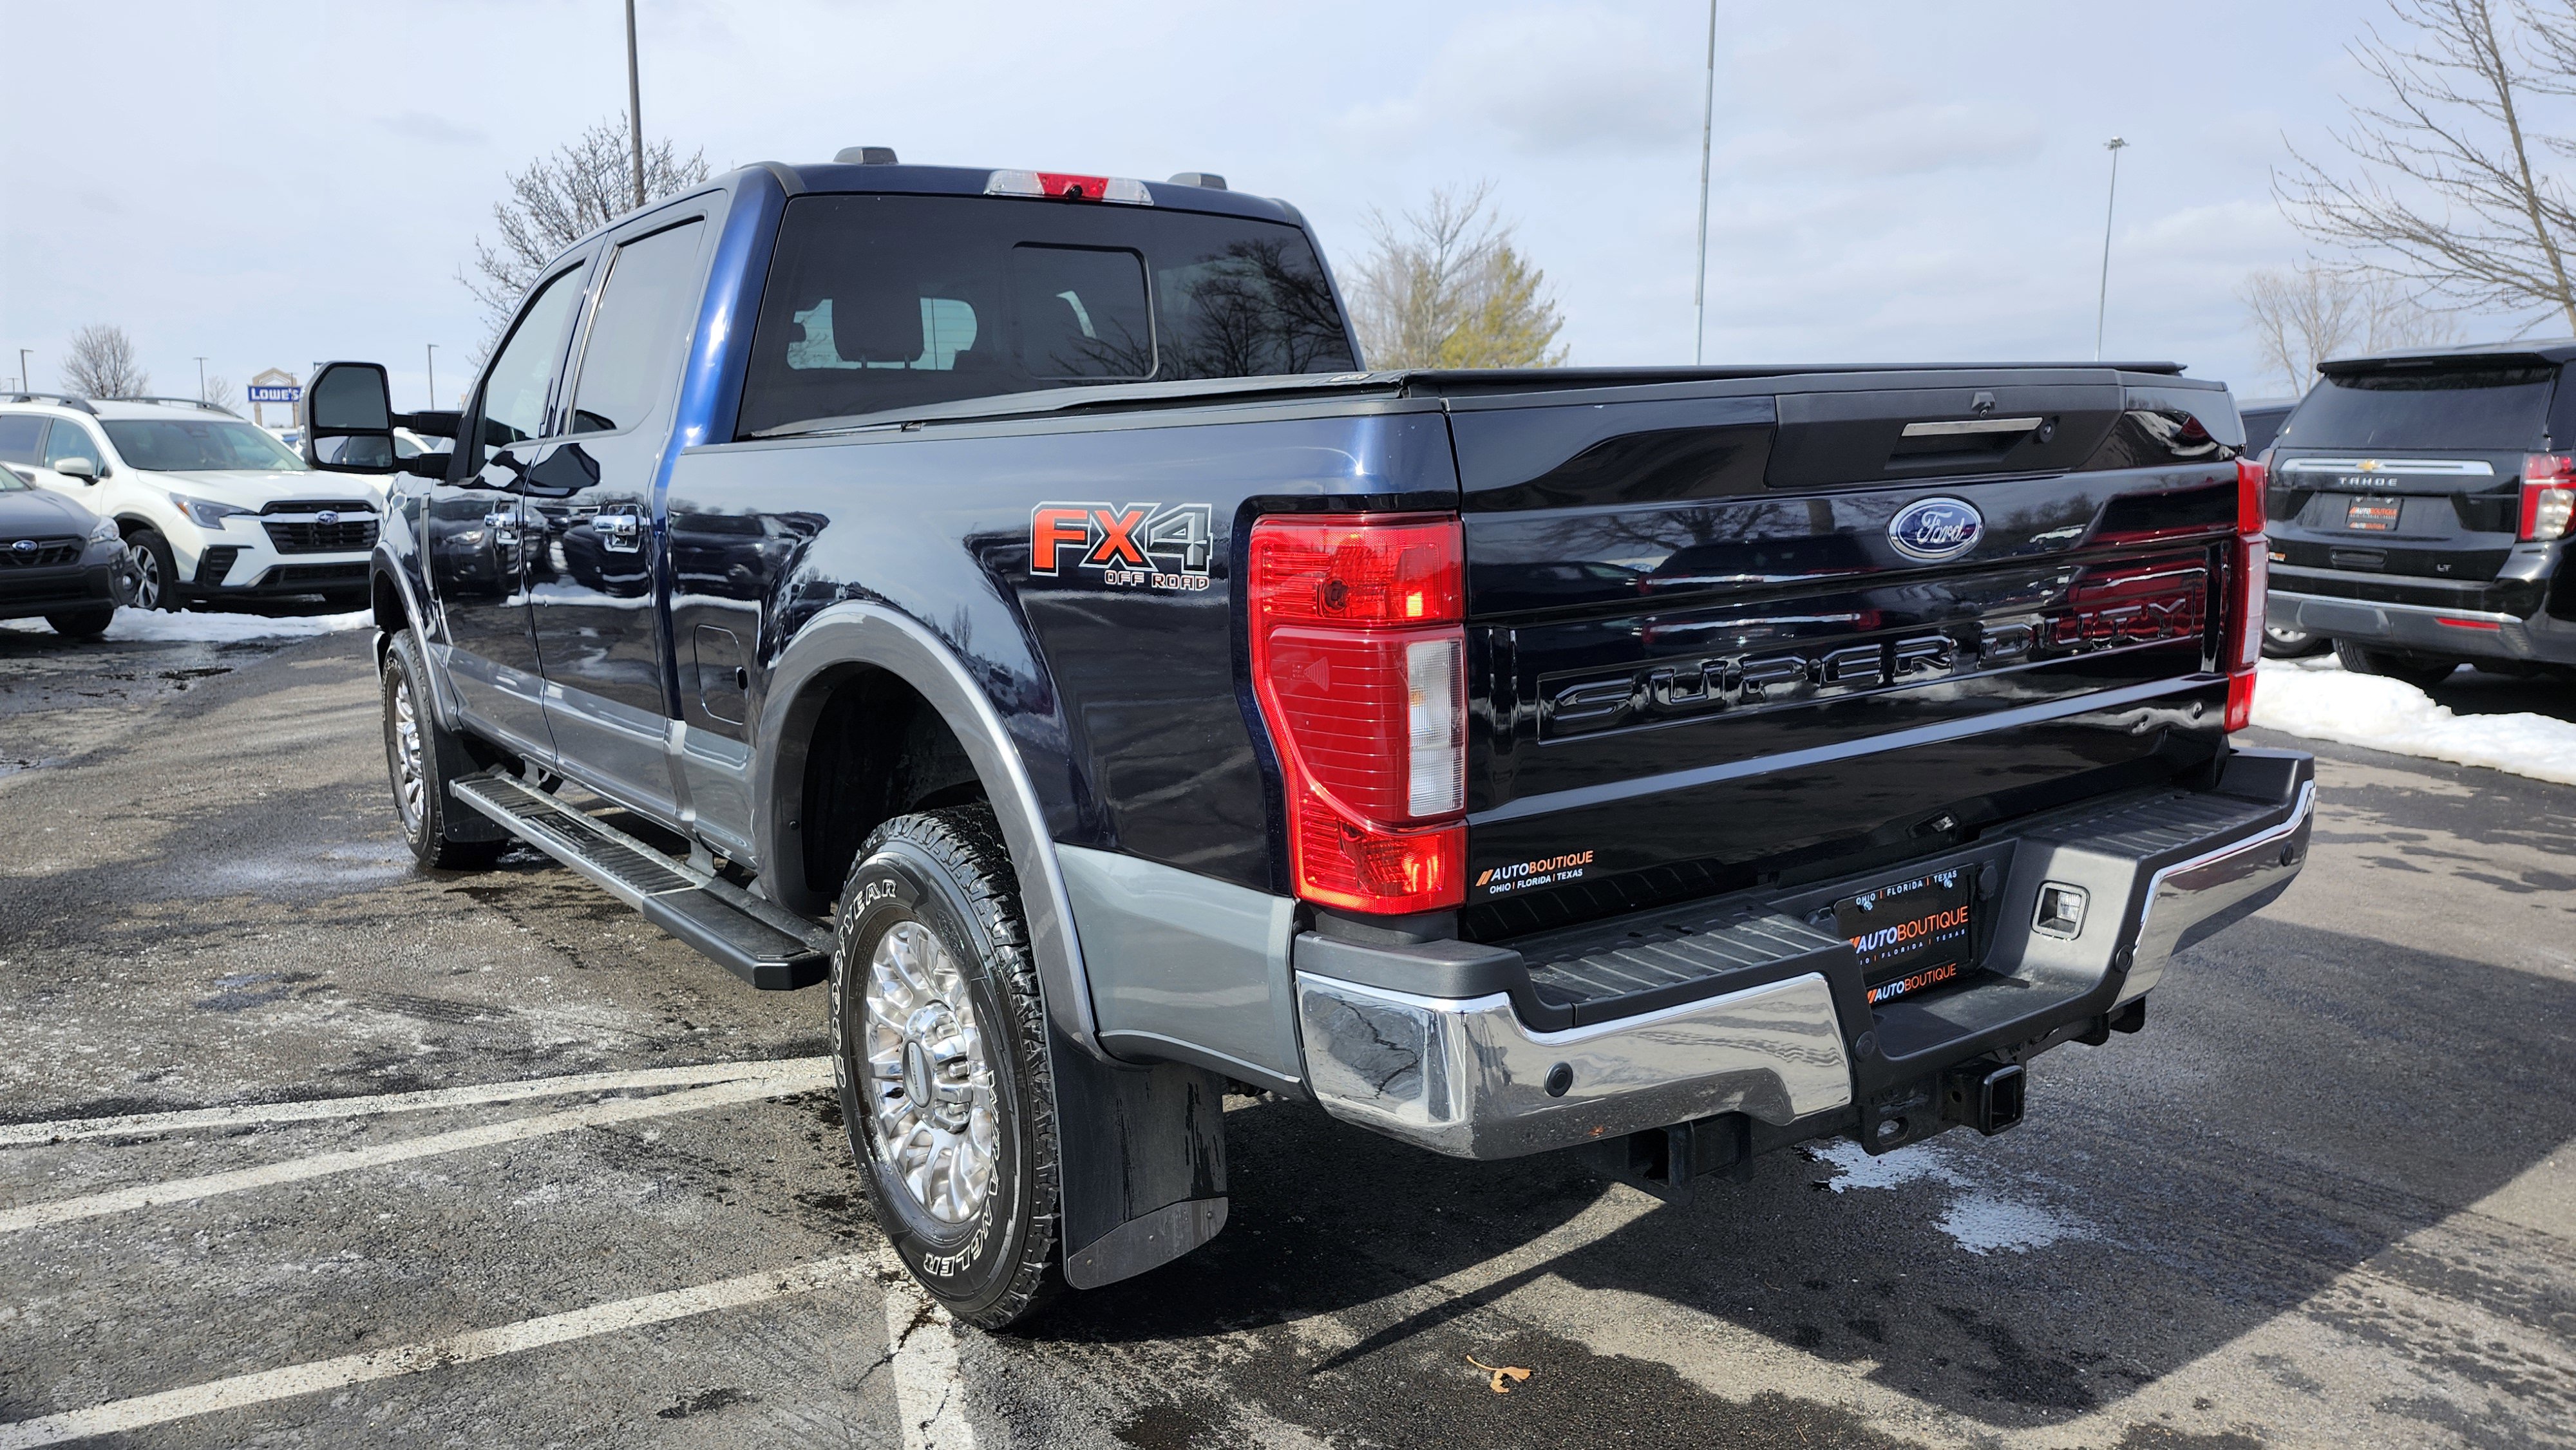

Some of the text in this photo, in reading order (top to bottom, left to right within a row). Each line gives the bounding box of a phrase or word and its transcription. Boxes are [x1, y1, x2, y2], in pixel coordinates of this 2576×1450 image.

[251, 387, 299, 400] LOWE'S
[2338, 476, 2398, 487] TAHOE
[1030, 500, 1213, 577] FX4
[1916, 511, 1967, 545] Ford
[1104, 569, 1210, 591] OFF ROAD
[2437, 563, 2452, 572] LT
[1553, 598, 2186, 725] SUPER DUTY
[1489, 868, 1584, 894] OHIO FLORIDA TEXAS
[1490, 850, 1594, 881] AUTOBOUTIQUE
[1855, 869, 1957, 906] OHIO FLORIDA TEXAS
[1856, 905, 1969, 954] AUTOBOUTIQUE
[1881, 941, 1923, 959] FLORIDA
[1936, 928, 1965, 943] TEXAS
[831, 879, 897, 1089] GOODYEAR
[1874, 963, 1956, 1002] AUTOBOUTIQUE
[923, 1069, 1001, 1277] WRANGLER
